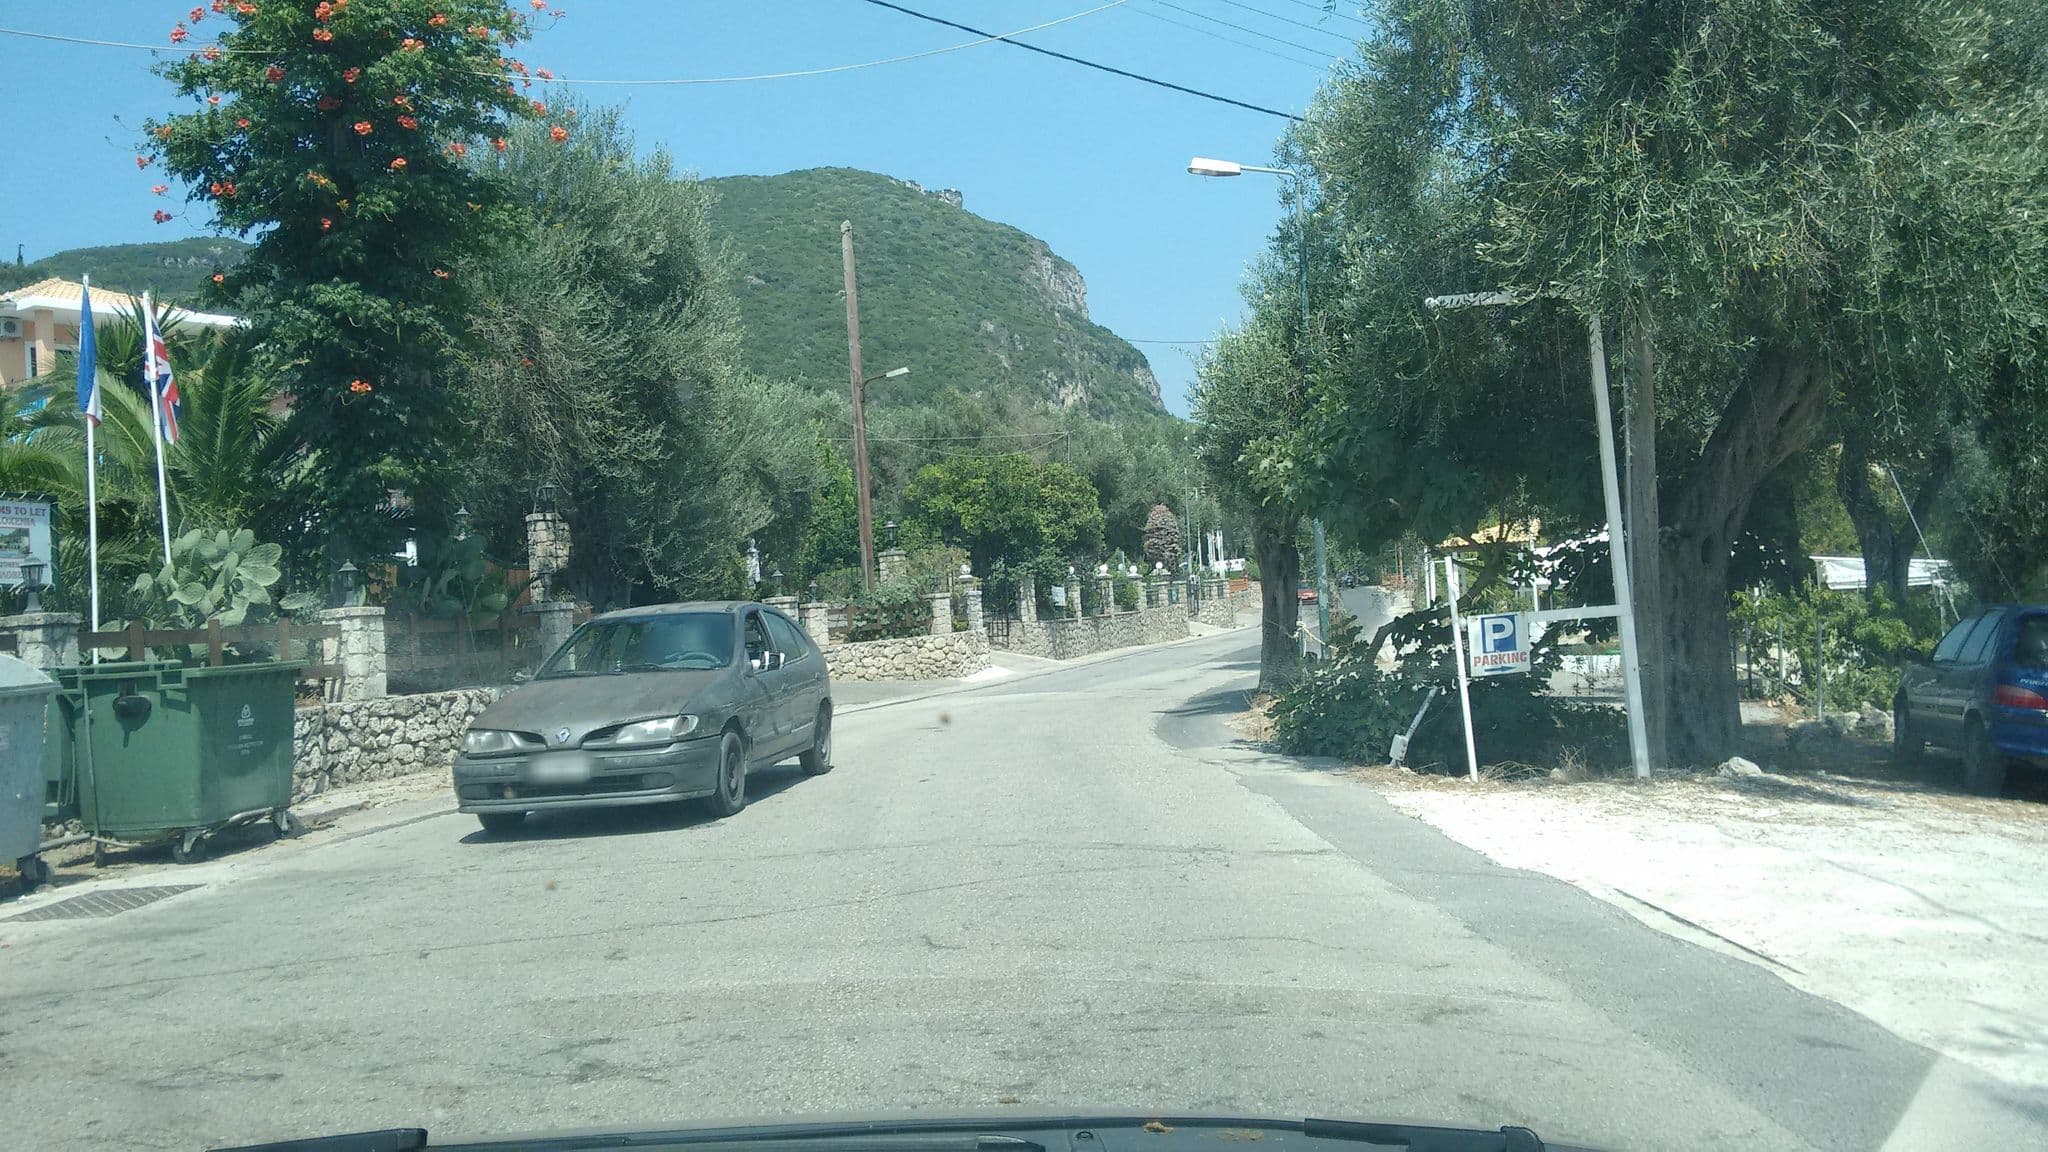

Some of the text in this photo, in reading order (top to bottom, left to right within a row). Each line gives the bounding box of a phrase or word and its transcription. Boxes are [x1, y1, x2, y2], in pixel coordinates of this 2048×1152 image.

[14, 506, 27, 515] TO
[29, 507, 48, 517] LET
[1484, 618, 1514, 652] P
[1474, 651, 1527, 667] PARKING
